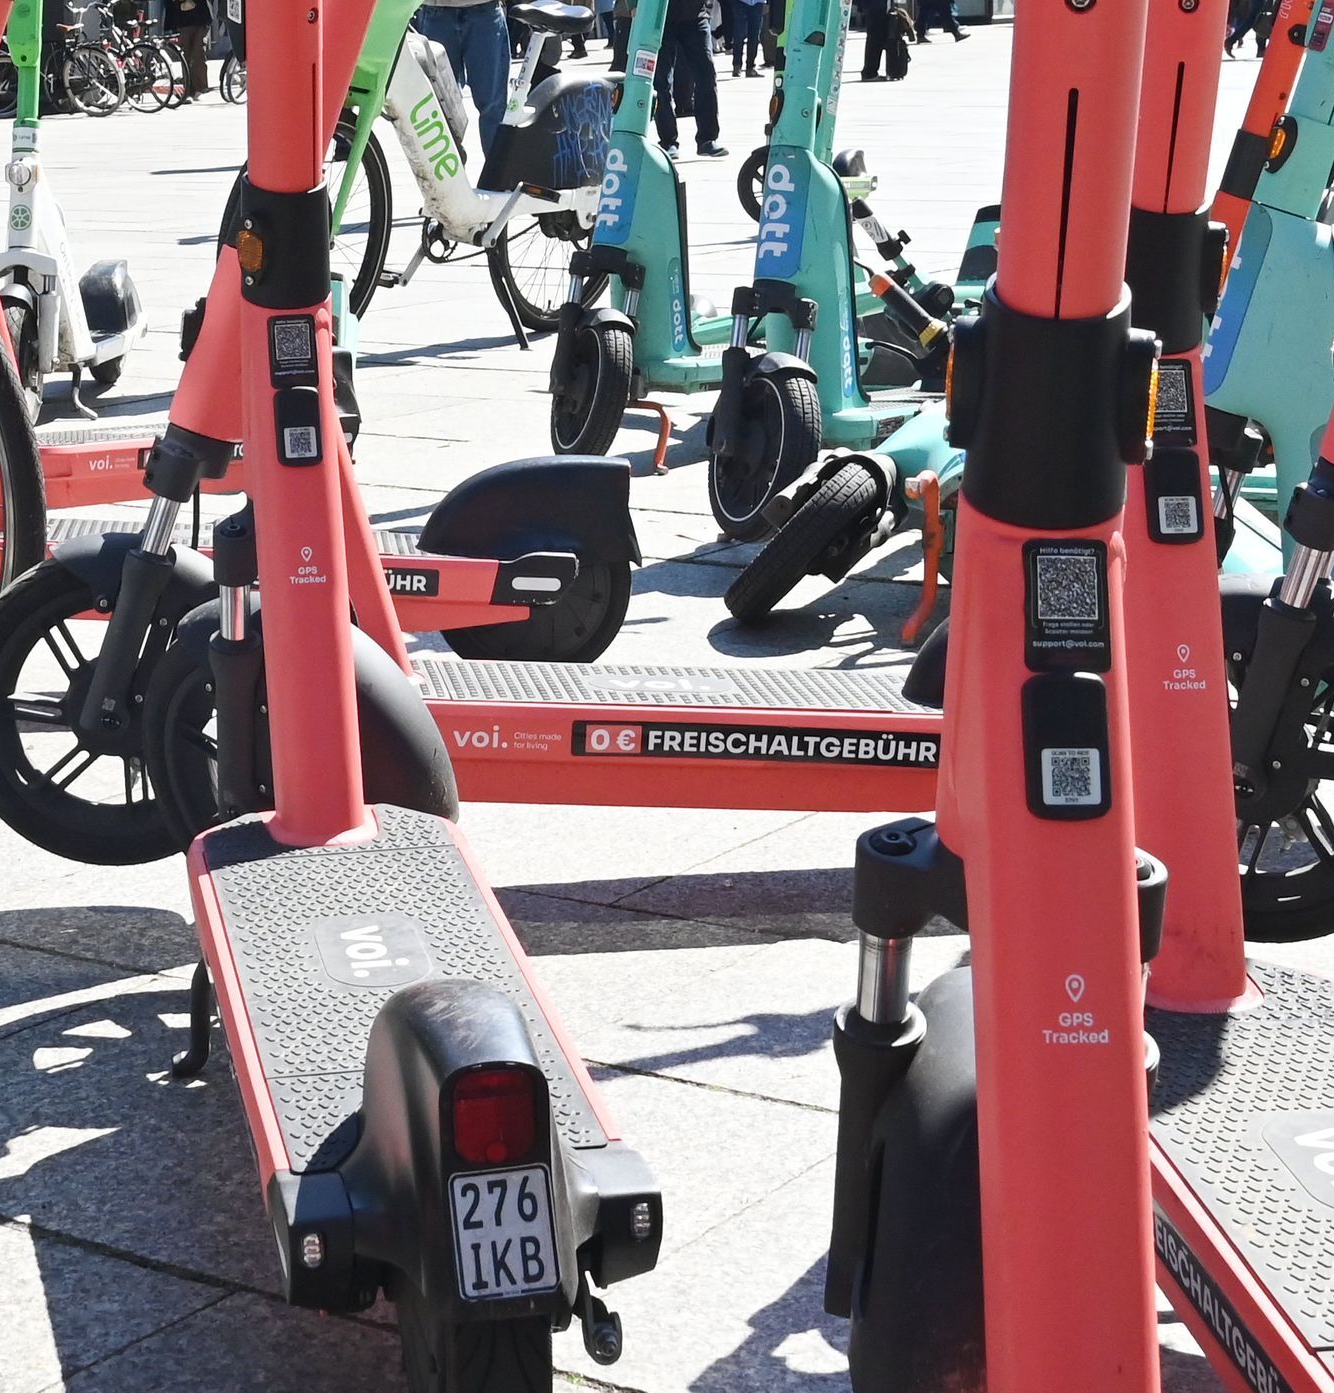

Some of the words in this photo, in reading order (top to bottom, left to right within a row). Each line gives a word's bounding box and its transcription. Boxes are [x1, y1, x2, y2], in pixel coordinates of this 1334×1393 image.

[409, 92, 460, 182] Lime
[595, 148, 627, 228] dott
[758, 165, 795, 259] dott
[672, 299, 684, 345] dott
[89, 454, 113, 472] voi.
[289, 575, 327, 584] Tracked
[298, 567, 318, 575] GPS
[1033, 640, 1105, 650] support@voi.com
[1173, 669, 1196, 679] GPS
[1163, 680, 1207, 690] Tracked
[453, 724, 508, 749] voi.
[513, 732, 535, 740] Cities
[538, 733, 562, 741] made
[513, 741, 523, 749] for
[525, 741, 549, 751] living
[591, 729, 609, 751] 0
[616, 729, 636, 752] €
[647, 730, 937, 763] FREISCHALTGEBÜHR
[339, 923, 411, 979] voi.
[1058, 1012, 1094, 1027] GPS
[1043, 1029, 1109, 1044] Tracked
[459, 1175, 539, 1231] 276
[471, 1236, 548, 1290] IKB
